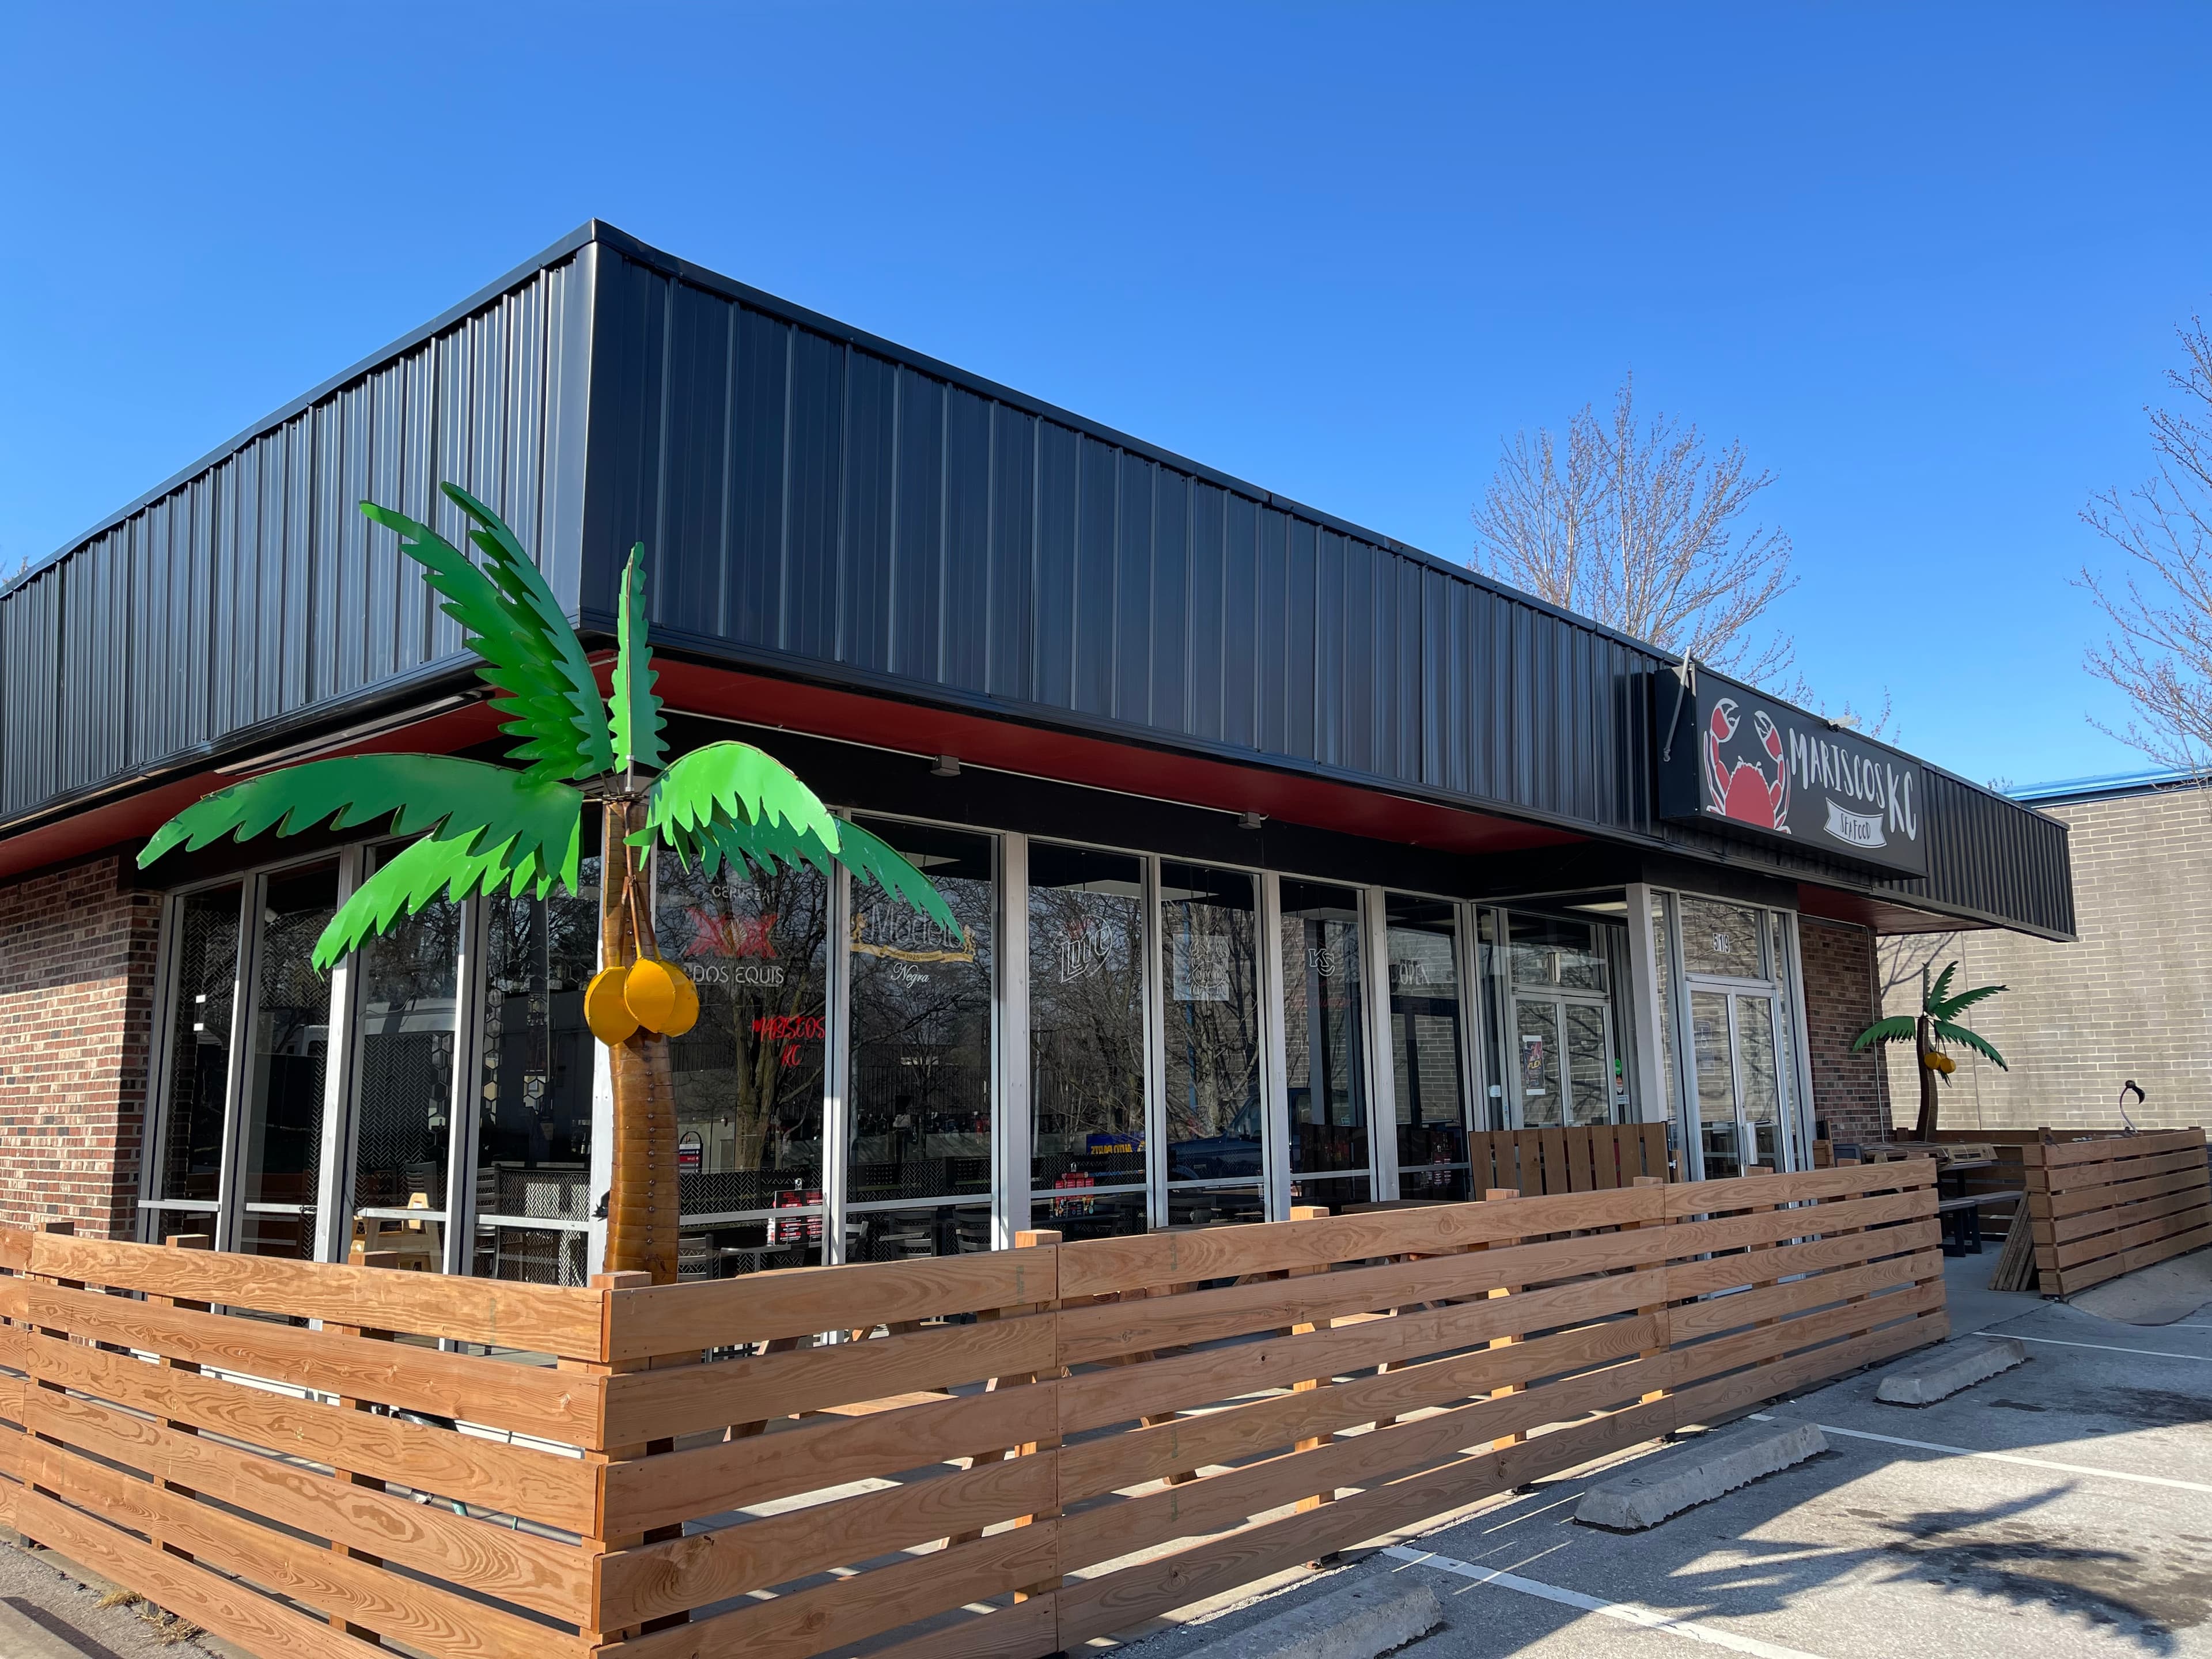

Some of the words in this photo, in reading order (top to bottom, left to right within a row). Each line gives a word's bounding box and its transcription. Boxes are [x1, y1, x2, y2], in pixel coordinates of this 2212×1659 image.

[1789, 728, 1885, 809] MARISCOS
[1887, 763, 1916, 841] KC
[1840, 813, 1871, 840] SEAFOOD
[1713, 934, 1729, 952] 519
[906, 952, 920, 960] 1925
[1308, 948, 1335, 976] KC
[693, 965, 729, 983] DOS
[735, 967, 784, 984] EQUIS
[891, 963, 930, 988] Negra
[1399, 963, 1430, 986] OPEN
[752, 1015, 825, 1041] MARISCOS
[781, 1044, 801, 1067] KC
